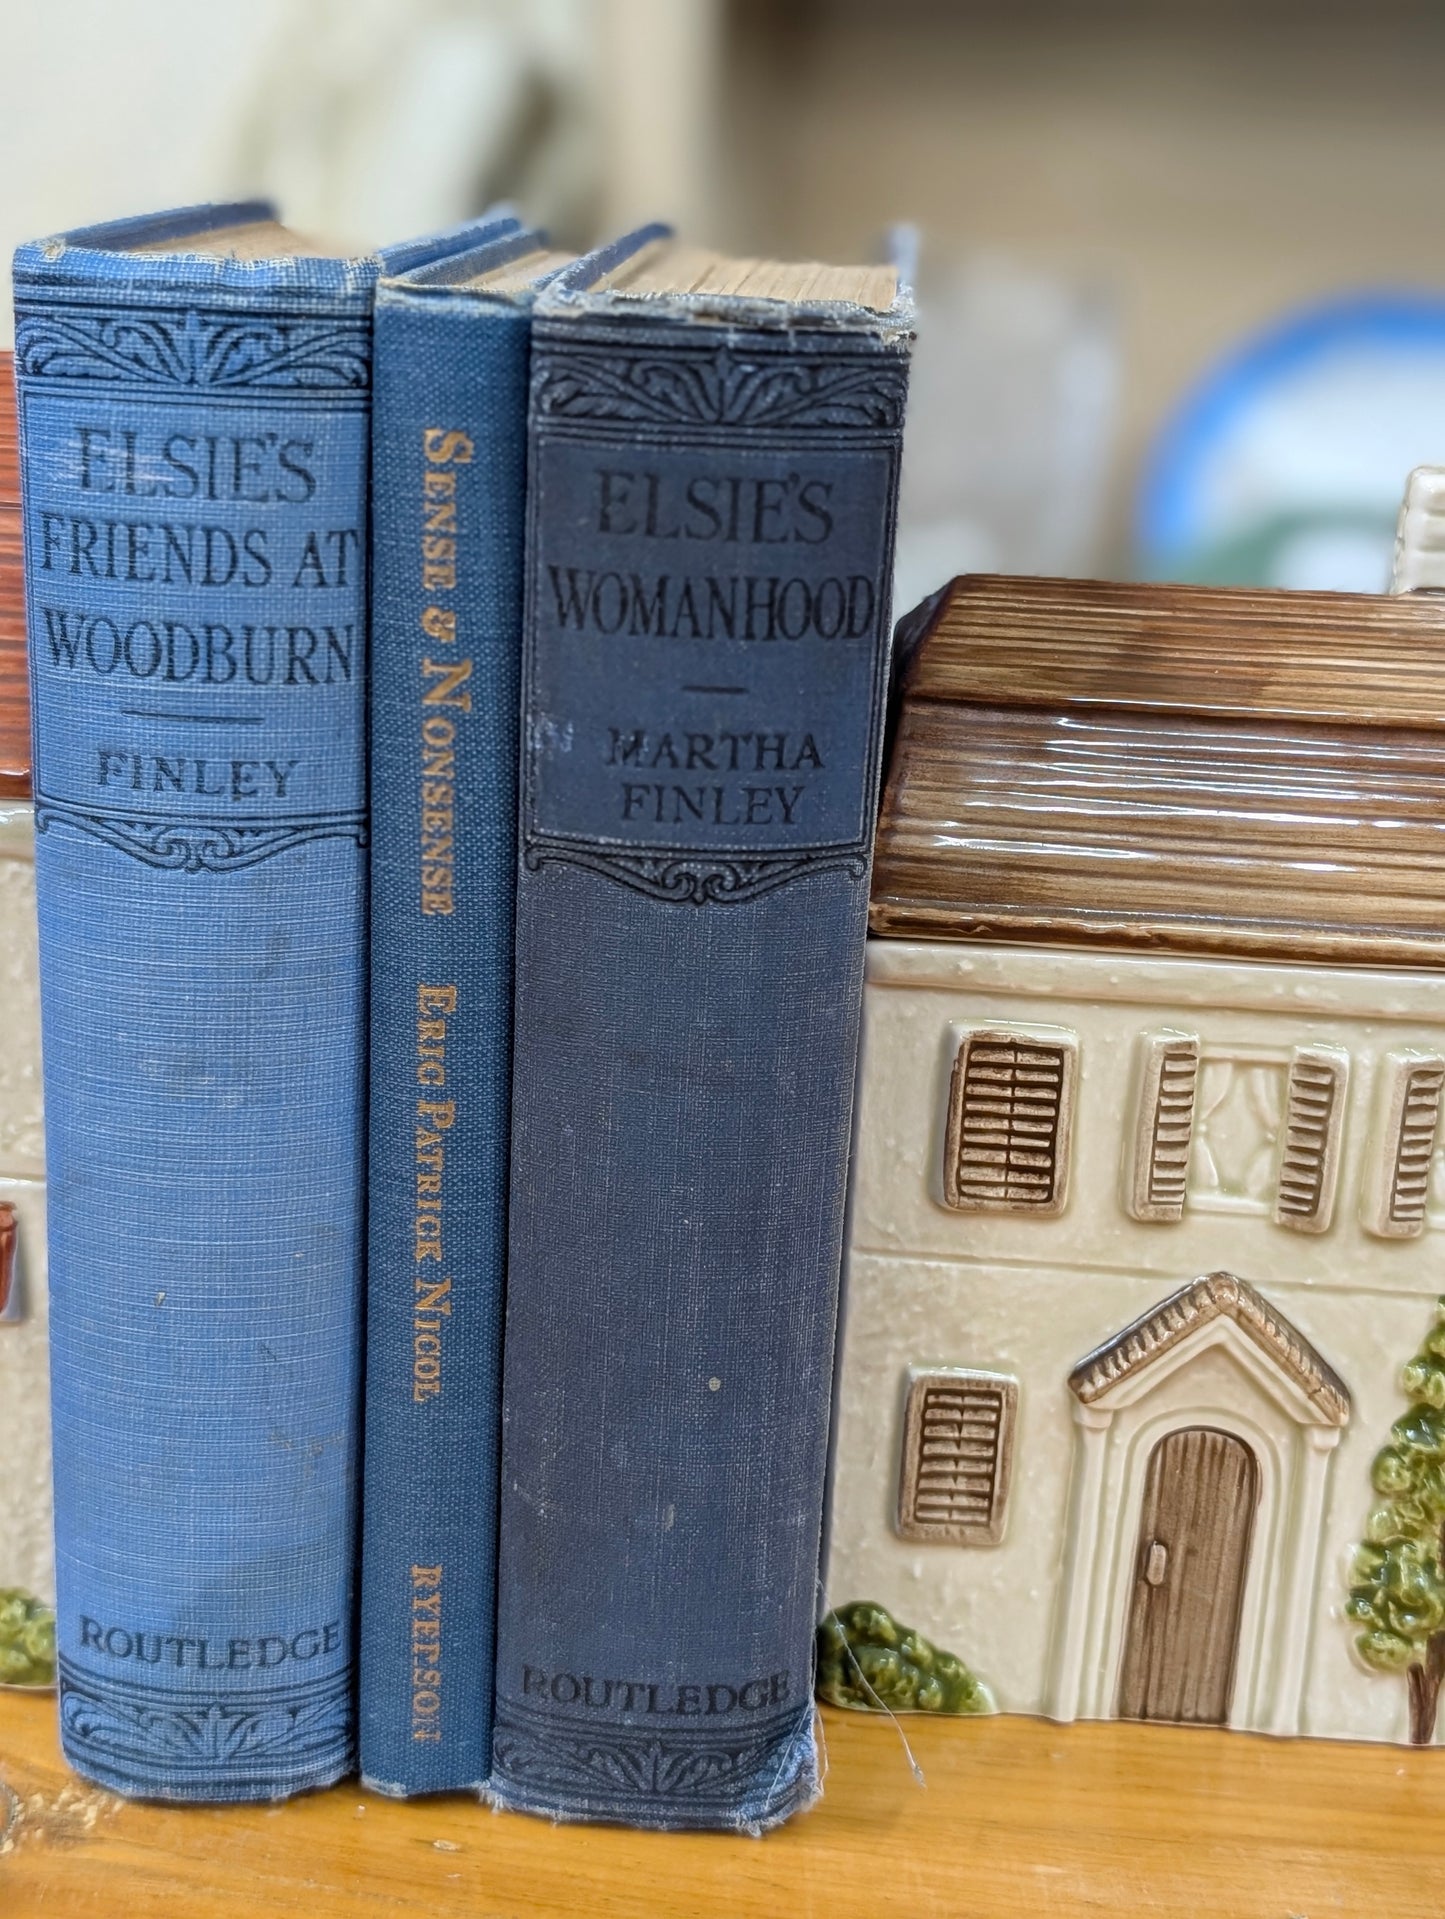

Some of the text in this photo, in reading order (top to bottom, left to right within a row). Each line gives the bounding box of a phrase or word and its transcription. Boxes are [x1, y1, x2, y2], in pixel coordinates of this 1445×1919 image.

[74, 427, 318, 503] ELSIE'S
[594, 468, 834, 544] ELSIE'S
[38, 511, 361, 588] FRIENDS AT
[547, 564, 876, 641] WOMANHOOD
[42, 608, 355, 686] WOODBURN
[420, 428, 474, 916] SENSE & NONSENSE
[97, 751, 301, 798] FINLEY
[605, 727, 825, 771] MARTHA
[621, 783, 806, 825] FINLEY
[412, 983, 457, 1403] ERIC PATRICK NICOL
[79, 1615, 343, 1669] ROUTLEDGE
[522, 1664, 791, 1715] ROUTLEDGE
